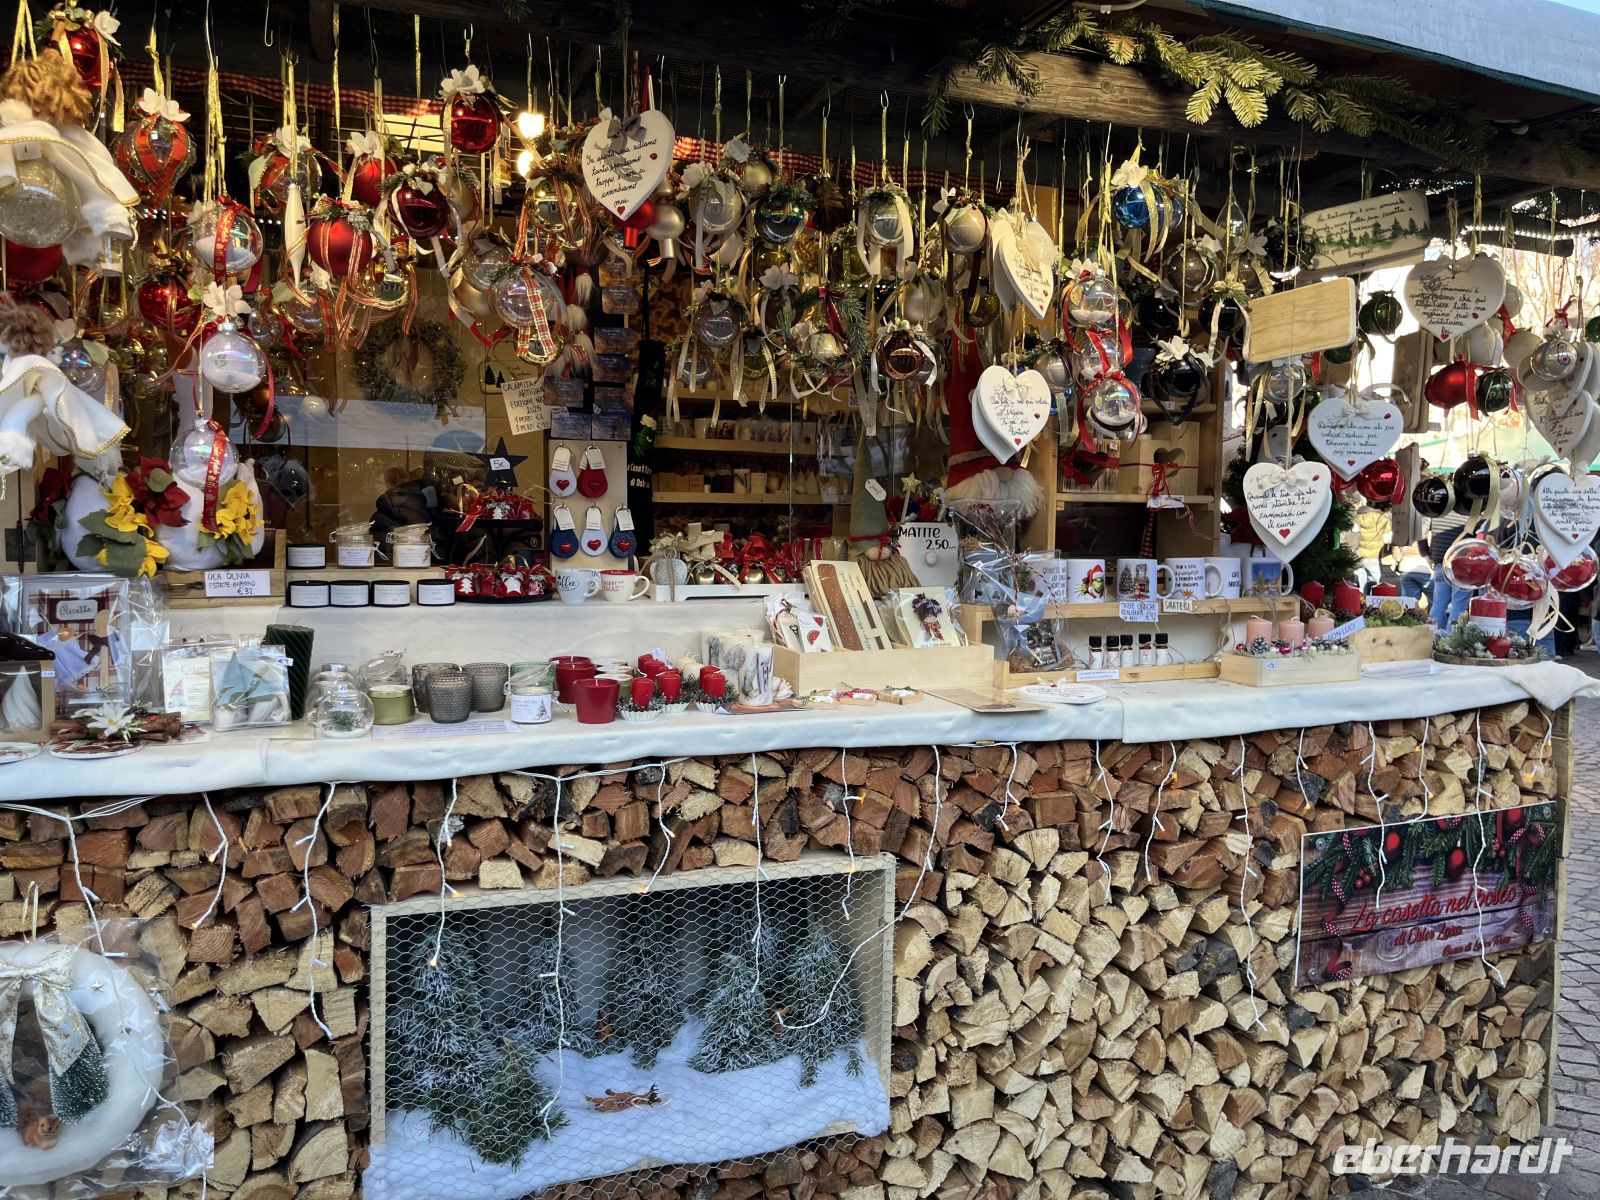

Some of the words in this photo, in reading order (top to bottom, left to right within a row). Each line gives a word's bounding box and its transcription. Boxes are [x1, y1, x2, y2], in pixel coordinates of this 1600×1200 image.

[502, 380, 535, 392] CALAMITA
[518, 386, 545, 398] ARTIGIAN
[509, 398, 535, 409] EDIZIONE
[1280, 490, 1291, 498] tue
[1252, 502, 1268, 511] sono
[1268, 519, 1275, 529] il
[1277, 521, 1297, 529] cuore
[897, 526, 941, 539] MATITE
[227, 572, 250, 580] OLIVIA
[1341, 623, 1356, 637] LUCI
[1352, 899, 1377, 932] La
[1381, 893, 1441, 925] casetta
[1447, 885, 1473, 913] nel
[1474, 885, 1516, 910] bosco
[1394, 930, 1407, 947] di
